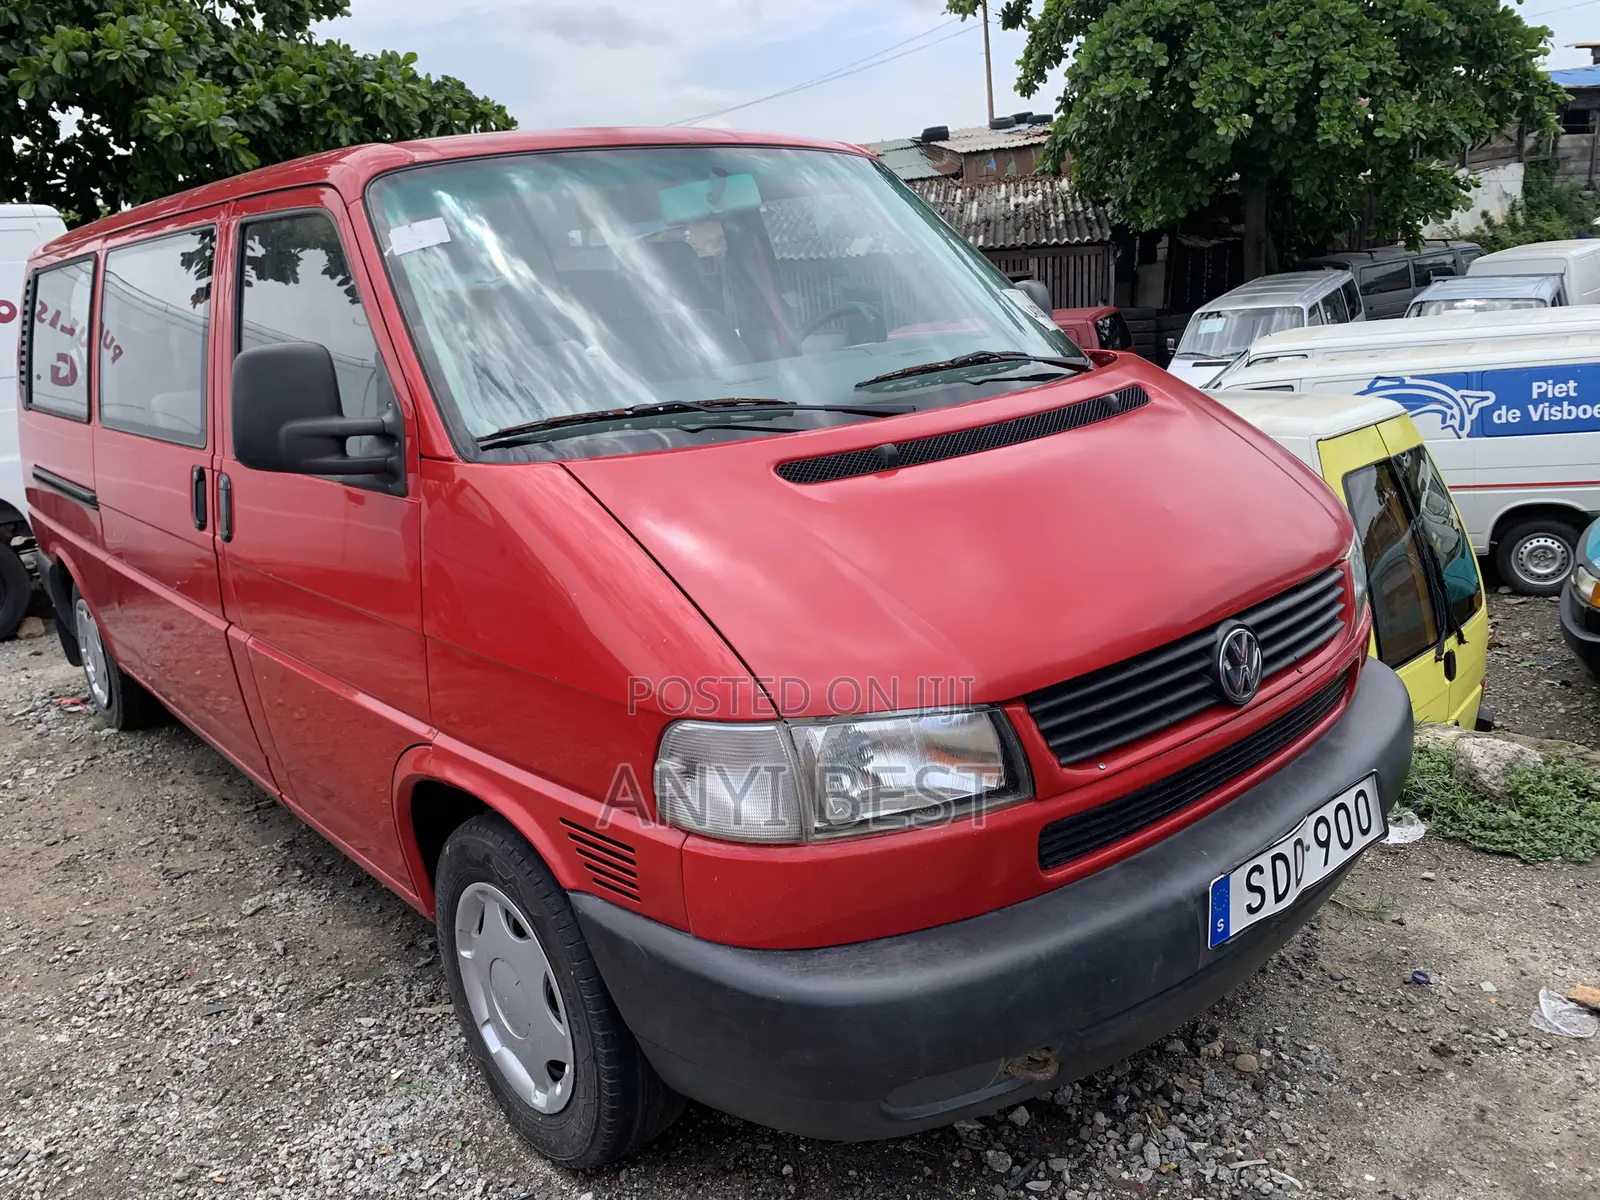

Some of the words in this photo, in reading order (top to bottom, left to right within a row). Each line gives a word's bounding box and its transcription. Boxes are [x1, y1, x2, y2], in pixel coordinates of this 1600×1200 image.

[1531, 379, 1578, 399] Piet
[1492, 405, 1521, 424] de
[1245, 837, 1305, 915] SDD
[1313, 788, 1372, 867] 900
[1216, 917, 1225, 933] S
